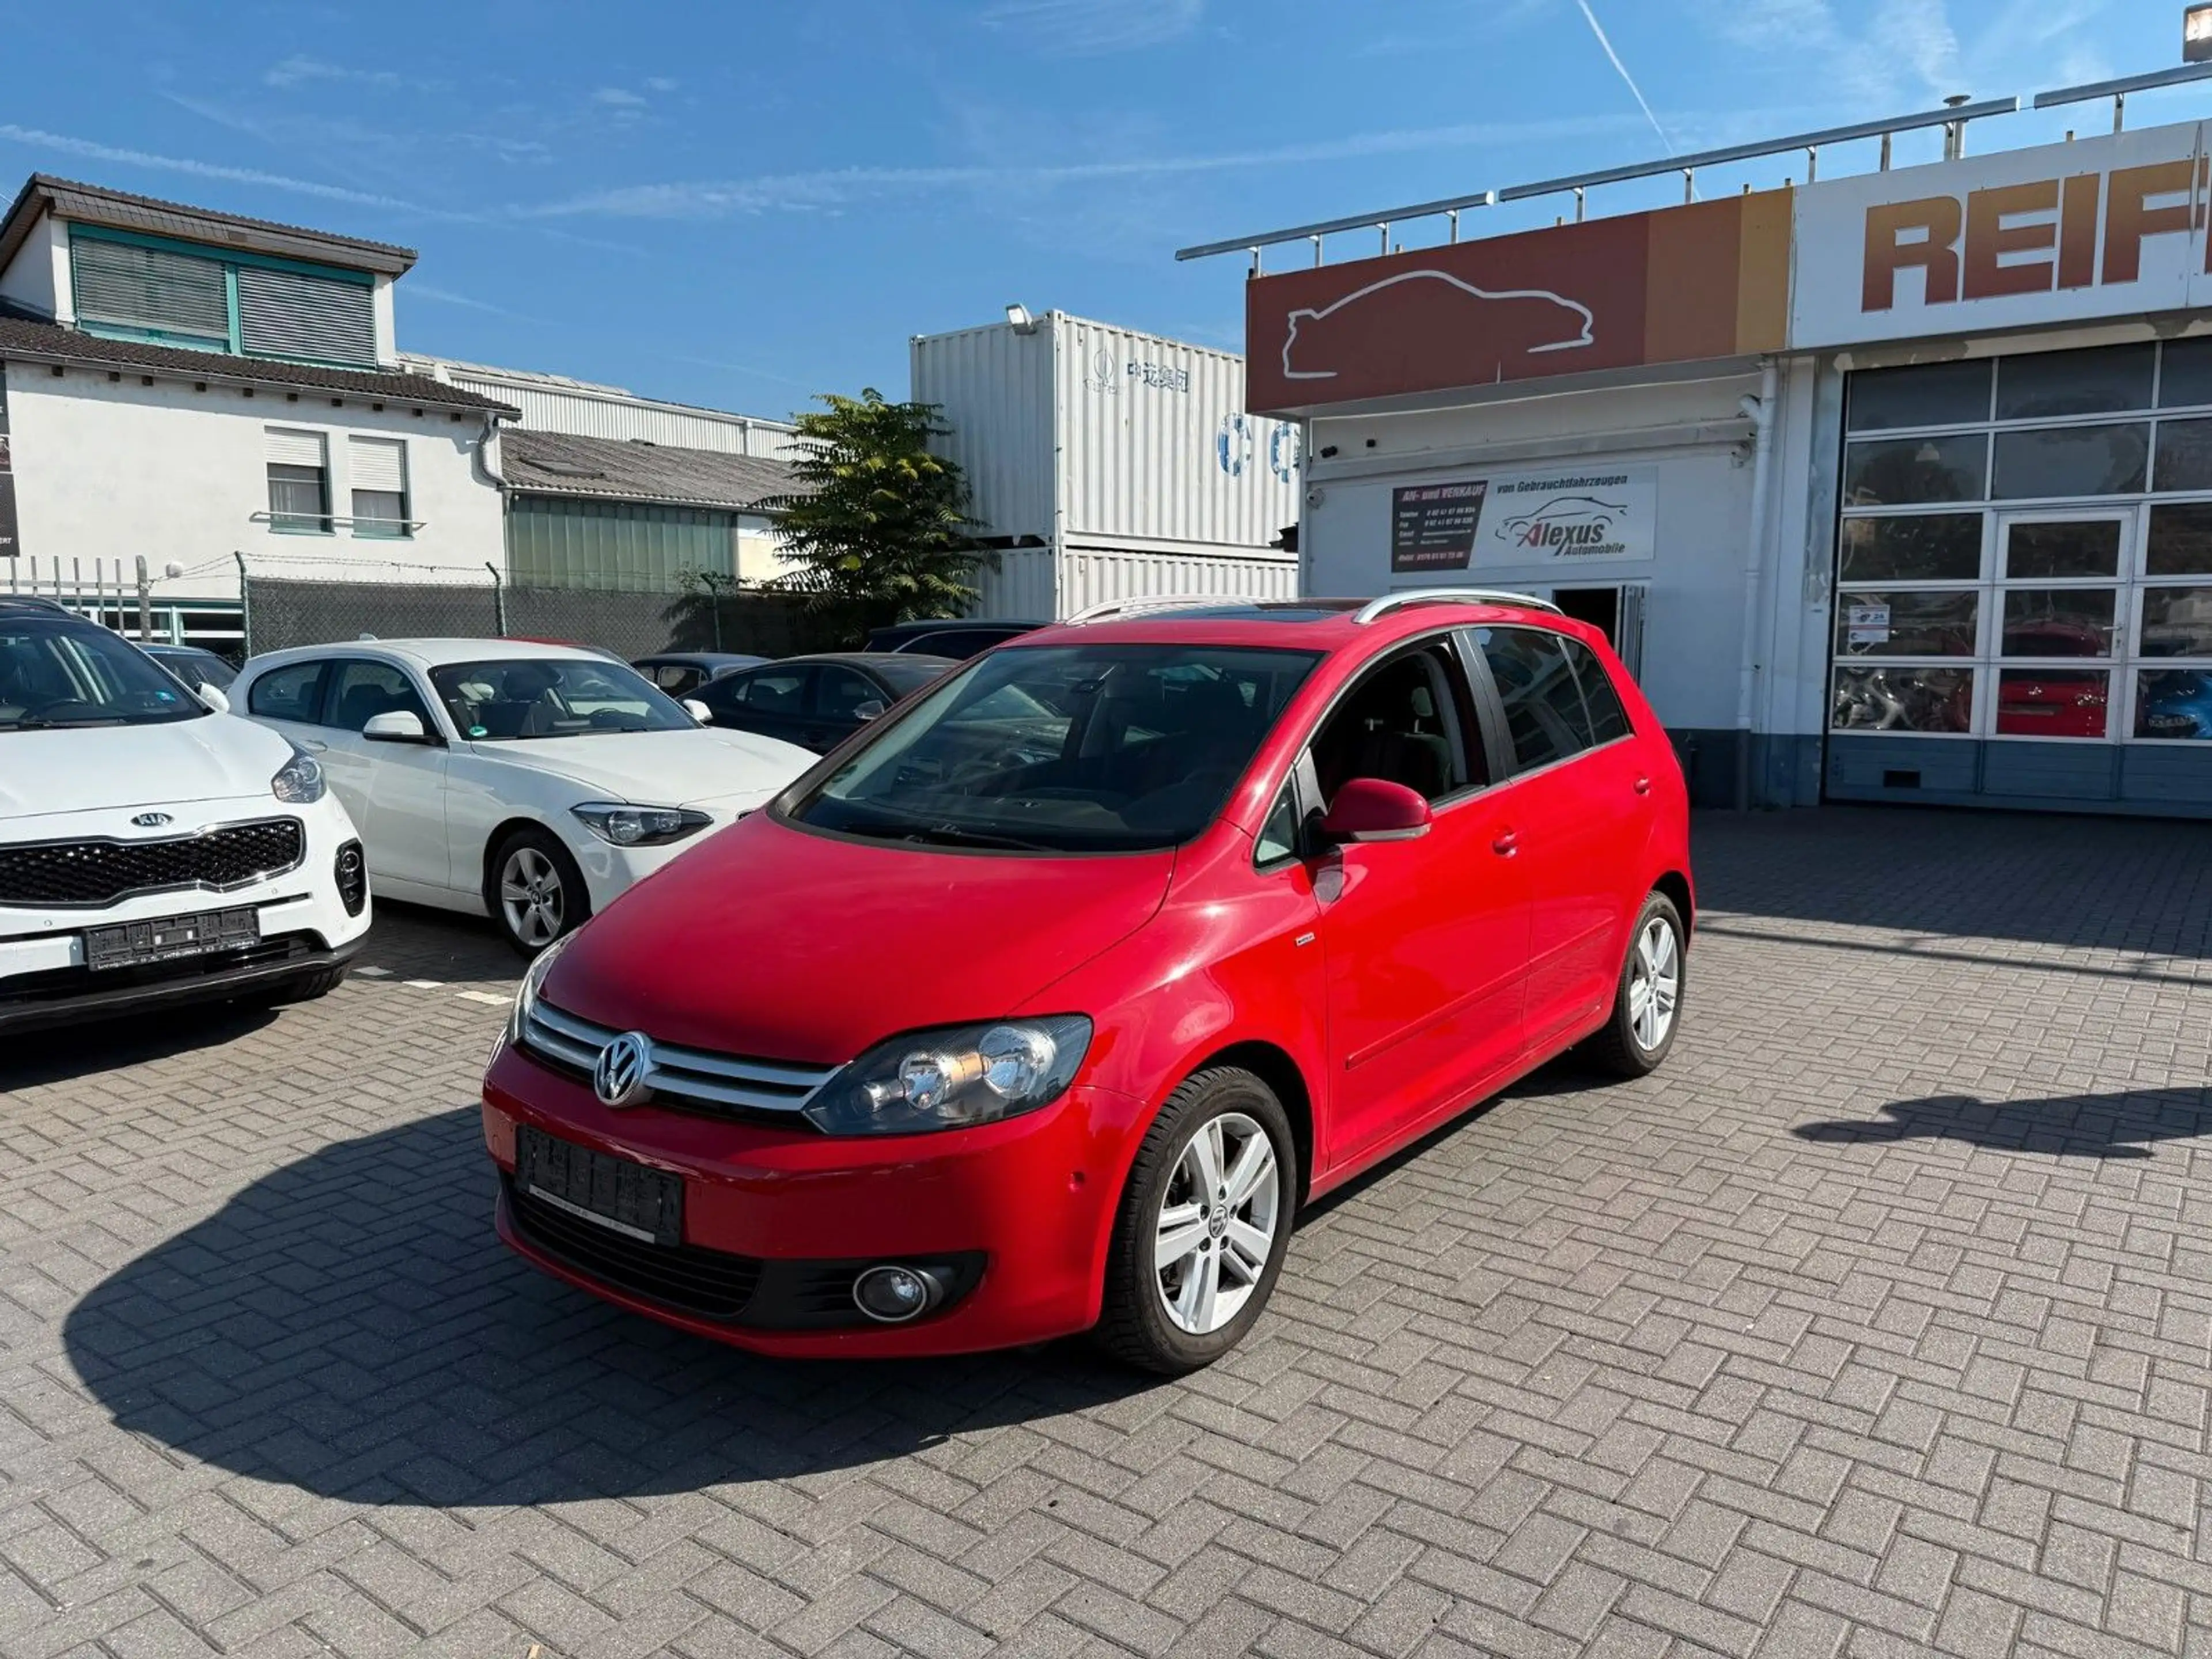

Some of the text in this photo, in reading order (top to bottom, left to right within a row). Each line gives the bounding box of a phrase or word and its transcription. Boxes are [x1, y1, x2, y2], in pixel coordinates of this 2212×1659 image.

[1862, 157, 2212, 312] REIF
[1442, 484, 1486, 498] VERKAUF
[1497, 475, 1628, 494] von Gebrauchtfahrzeugen
[1517, 521, 1605, 556] Alexus
[1563, 543, 1626, 556] Automobile
[136, 813, 170, 825] KIA
